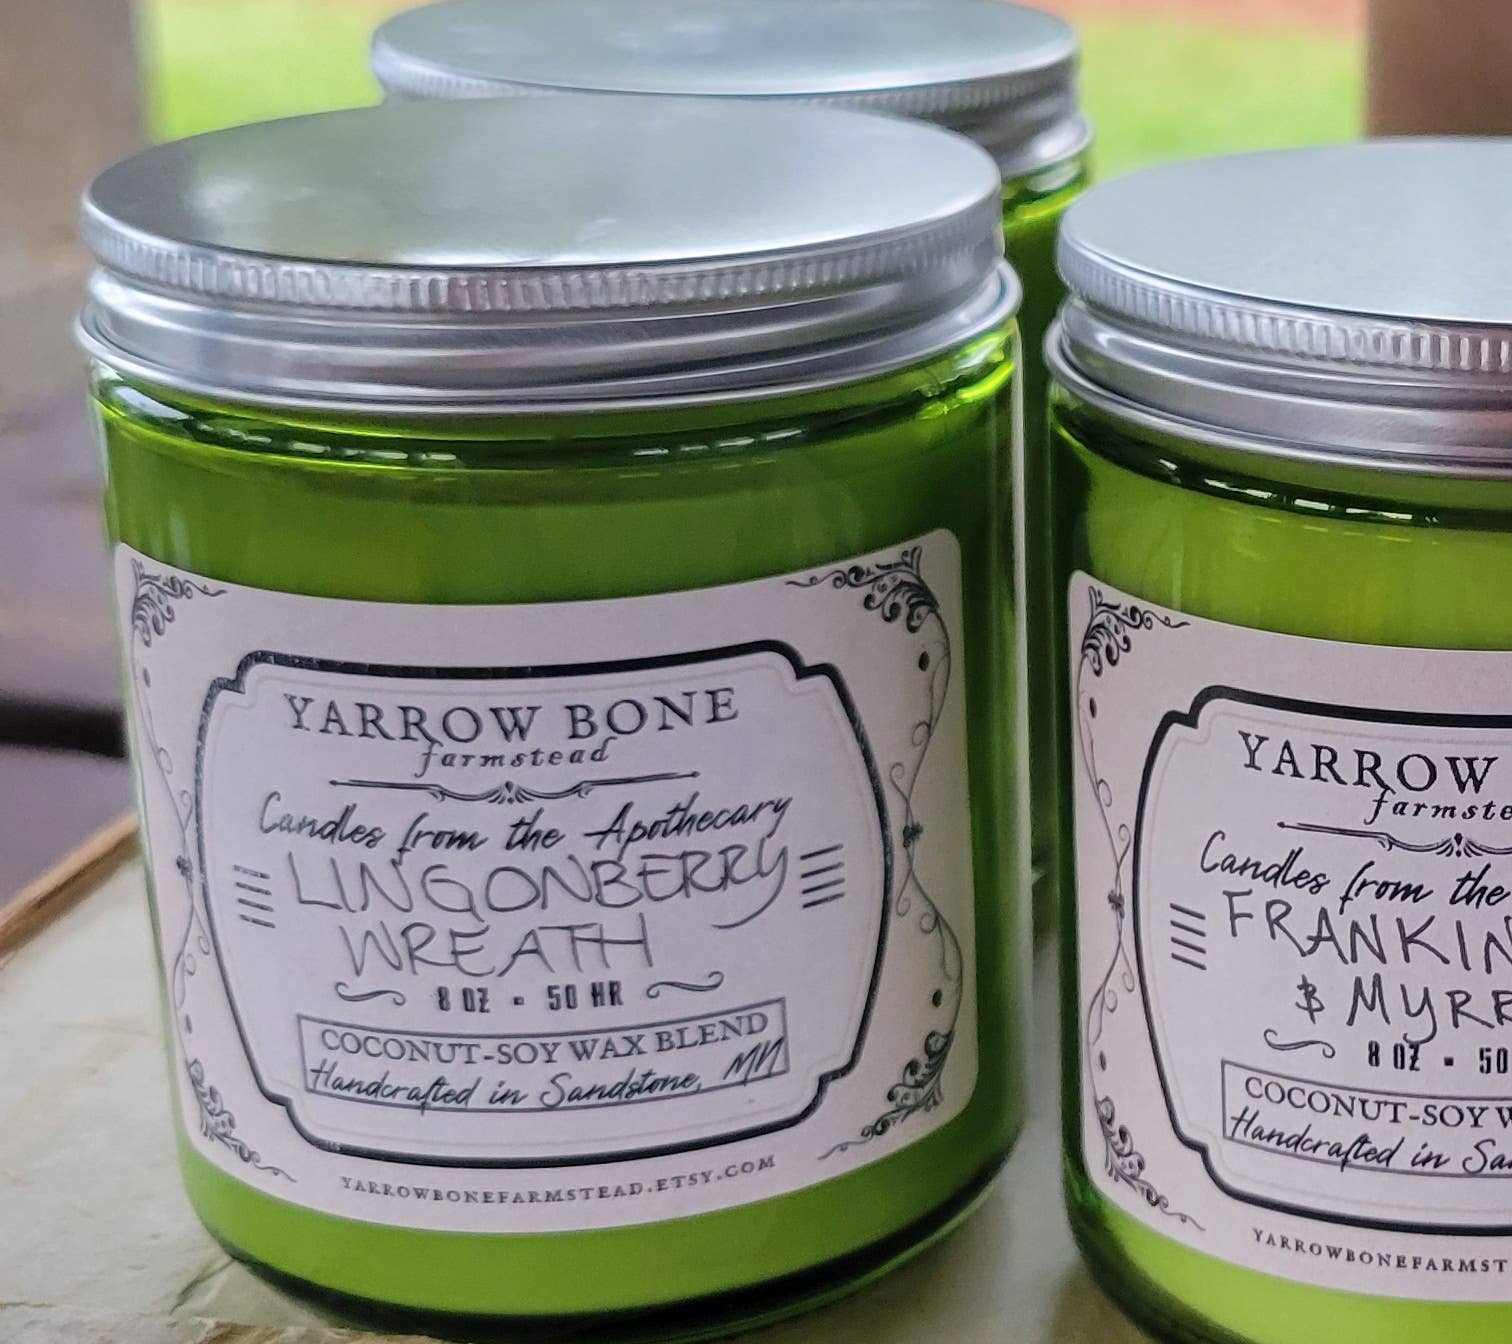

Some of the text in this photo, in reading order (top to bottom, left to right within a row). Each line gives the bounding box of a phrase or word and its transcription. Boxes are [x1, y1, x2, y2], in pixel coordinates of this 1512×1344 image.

[283, 687, 739, 746] YARROW BONE
[414, 737, 614, 777] farmstead
[1237, 731, 1499, 797] YARROW
[260, 791, 792, 865] Candles from the Apothecary
[287, 843, 788, 930] LINGONBERRY
[1201, 831, 1330, 894] Candles
[1339, 861, 1433, 912] from
[1449, 864, 1510, 906] the
[340, 913, 653, 977] WREATH
[436, 981, 624, 1013] 8 OZ 50 HR
[320, 1012, 769, 1066] COCONUT-SOY WAX BLEND
[1368, 1043, 1380, 1070] 8
[1392, 1045, 1421, 1073] OZ
[1478, 1047, 1508, 1074] 50
[306, 1058, 480, 1114] Handcrafted
[490, 1081, 526, 1107] in
[1245, 1076, 1486, 1129] COCONUT-SOY
[1227, 1108, 1399, 1171] Handcrafted
[1412, 1142, 1449, 1169] in
[341, 1155, 777, 1204] YARROWBONEFARMSTEAD.ETSY.COM
